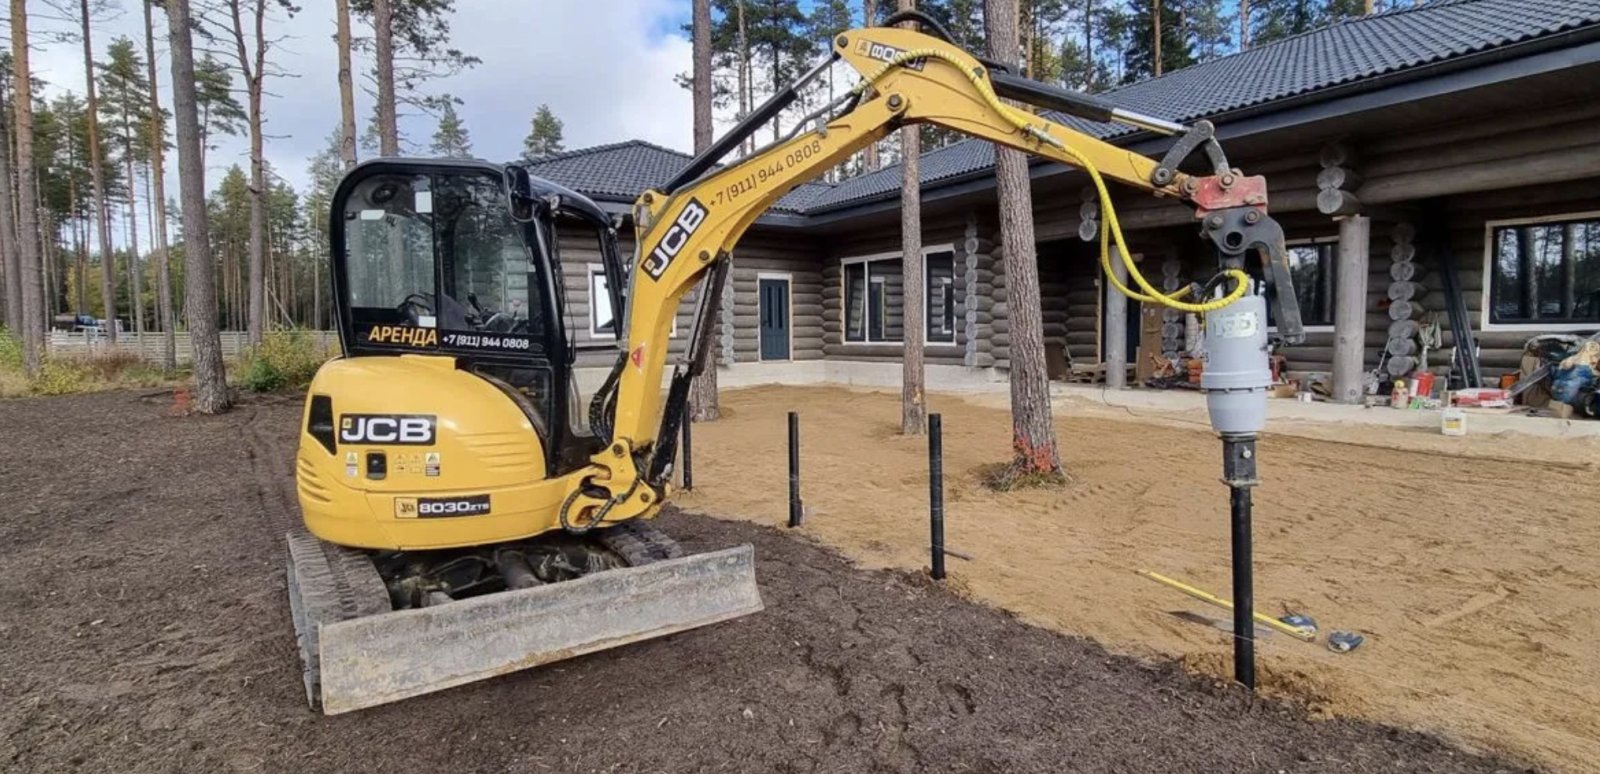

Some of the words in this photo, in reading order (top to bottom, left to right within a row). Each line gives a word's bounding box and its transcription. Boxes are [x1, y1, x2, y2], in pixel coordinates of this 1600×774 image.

[709, 193, 724, 207] +7
[726, 174, 757, 202] (911)
[758, 163, 784, 182] 944
[785, 140, 821, 168] 0808
[649, 202, 706, 277] JCB
[368, 325, 438, 347] АРЕНДА
[442, 334, 455, 344] +7
[456, 335, 480, 347] (911)
[481, 337, 501, 347] 944
[502, 338, 529, 349] 0808
[341, 418, 431, 442] JCB
